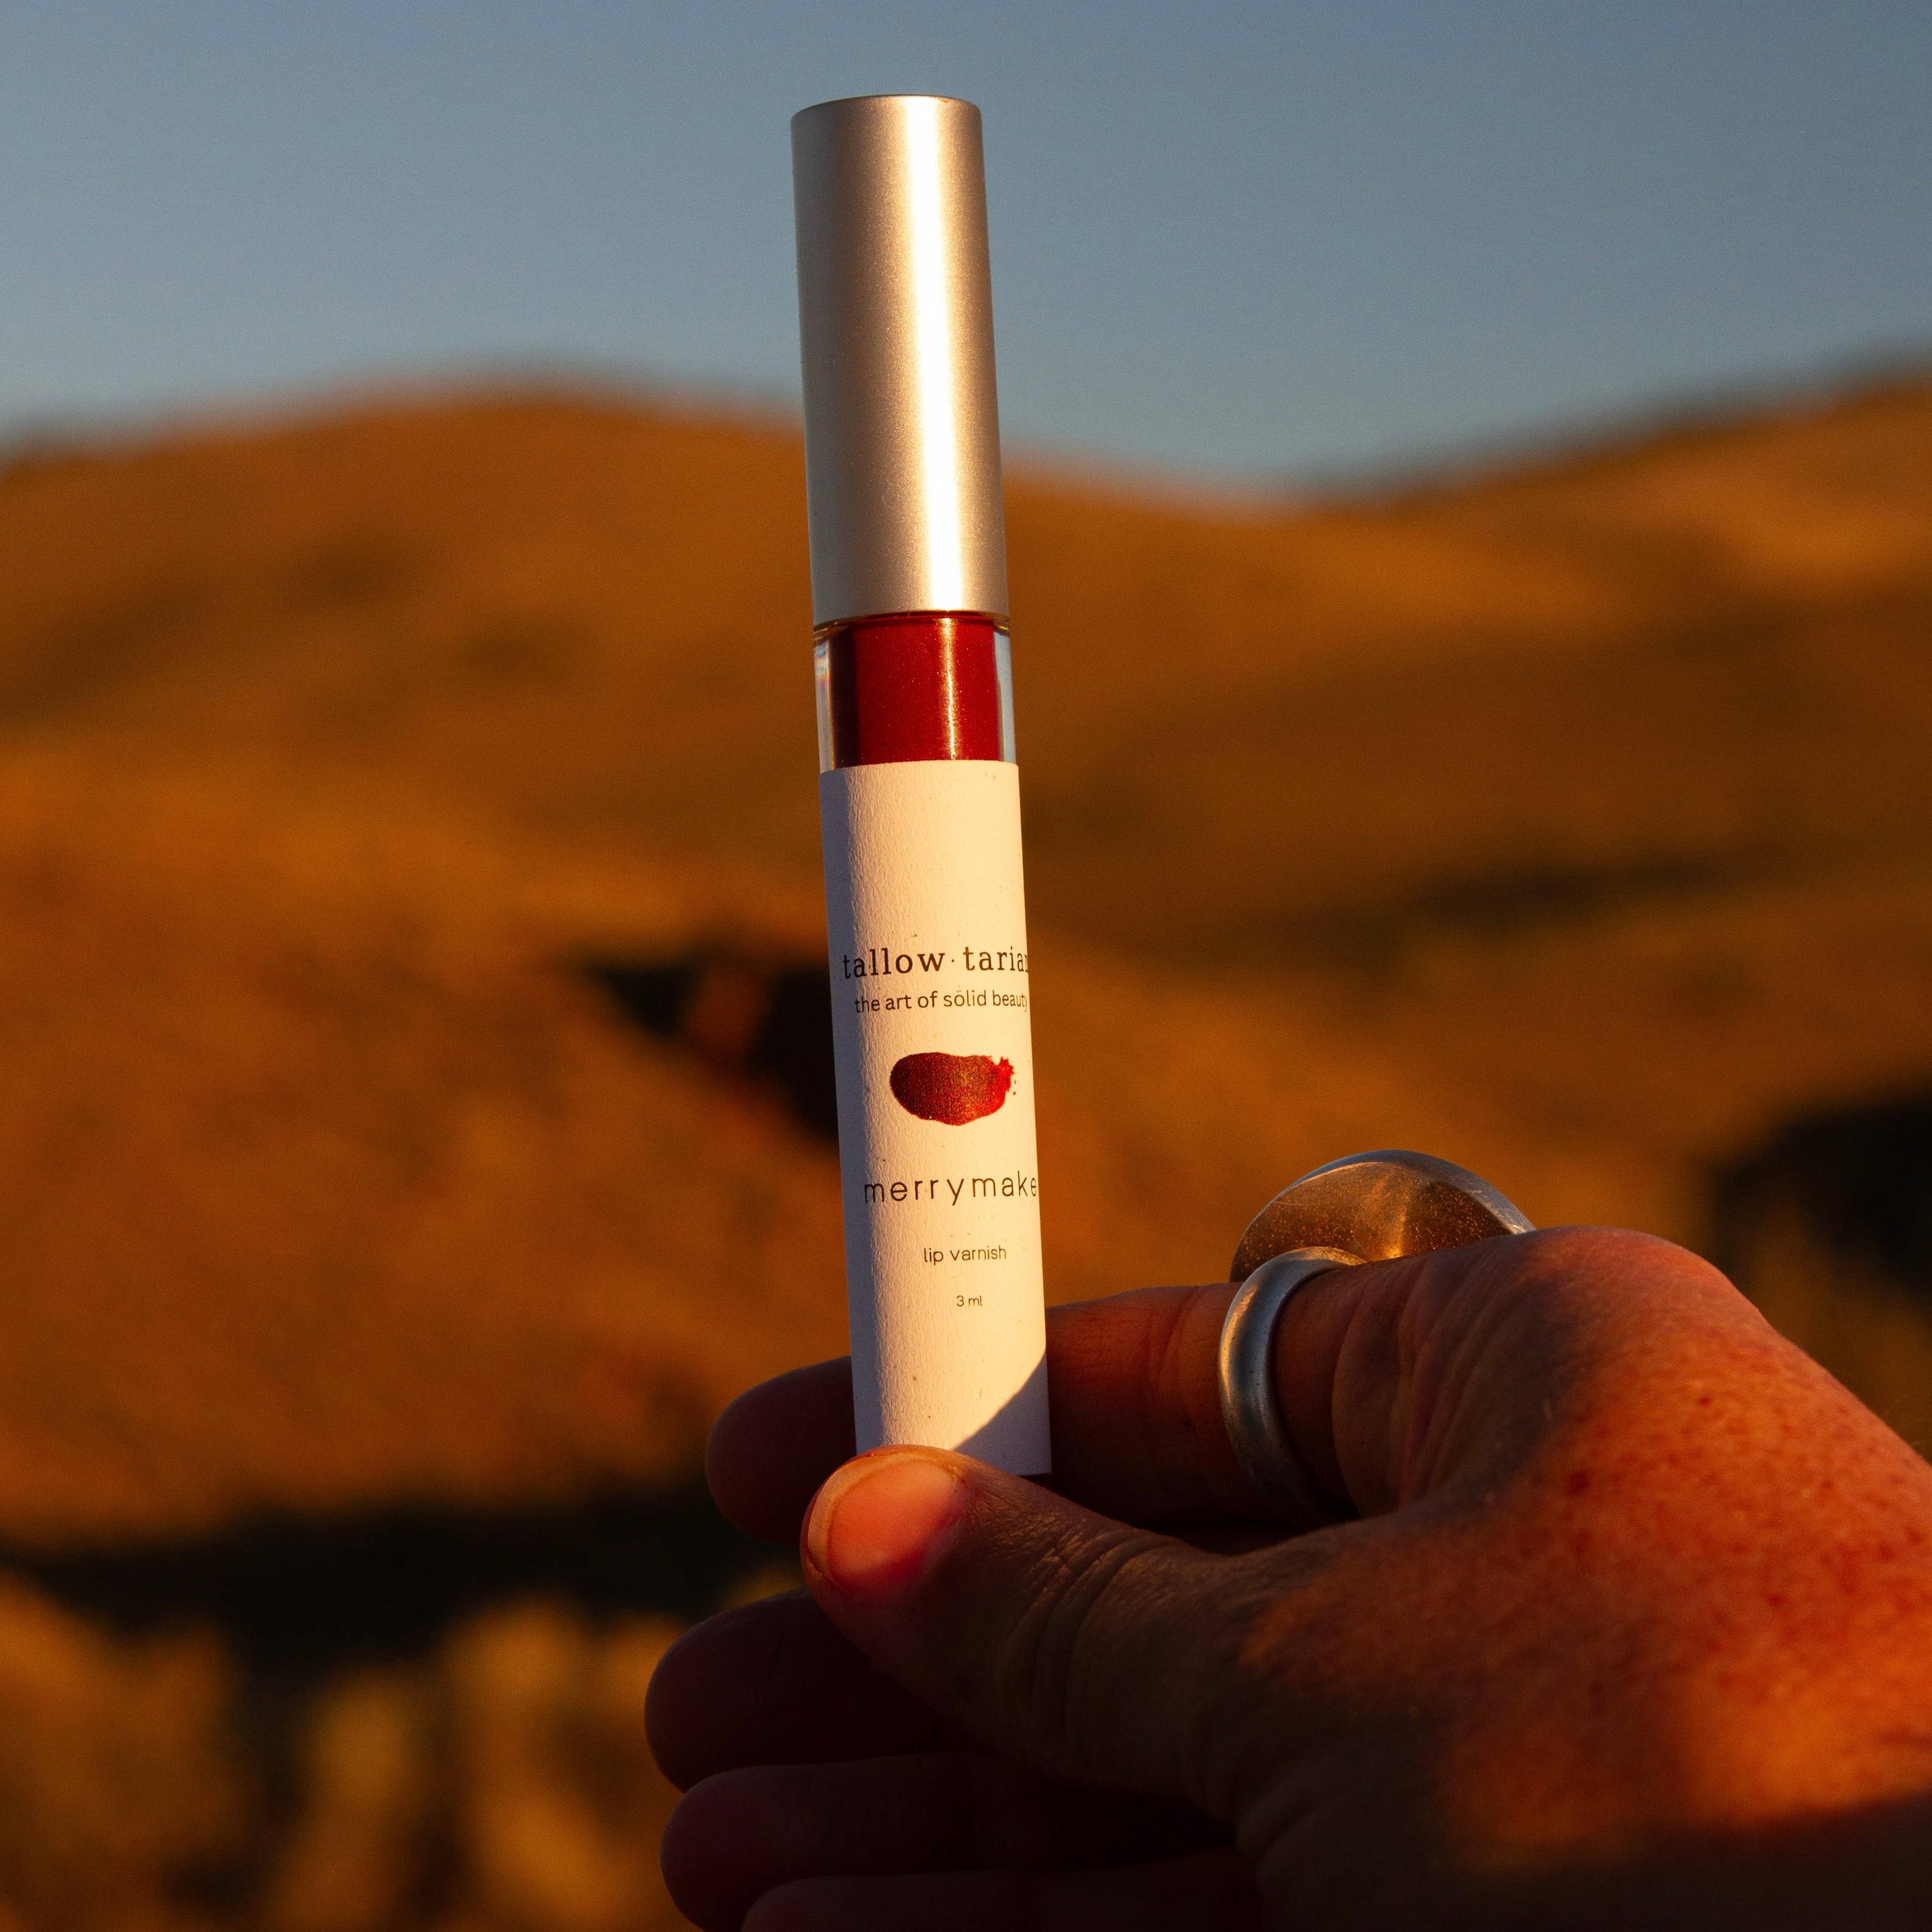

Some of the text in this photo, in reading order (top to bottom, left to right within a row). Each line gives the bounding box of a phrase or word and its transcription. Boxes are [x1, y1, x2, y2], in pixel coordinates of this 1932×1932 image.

[842, 947, 946, 980] tallow
[855, 989, 1028, 1013] the art of solid beauty
[923, 1244, 1007, 1266] lip varnish
[956, 1295, 983, 1307] 3 ml
